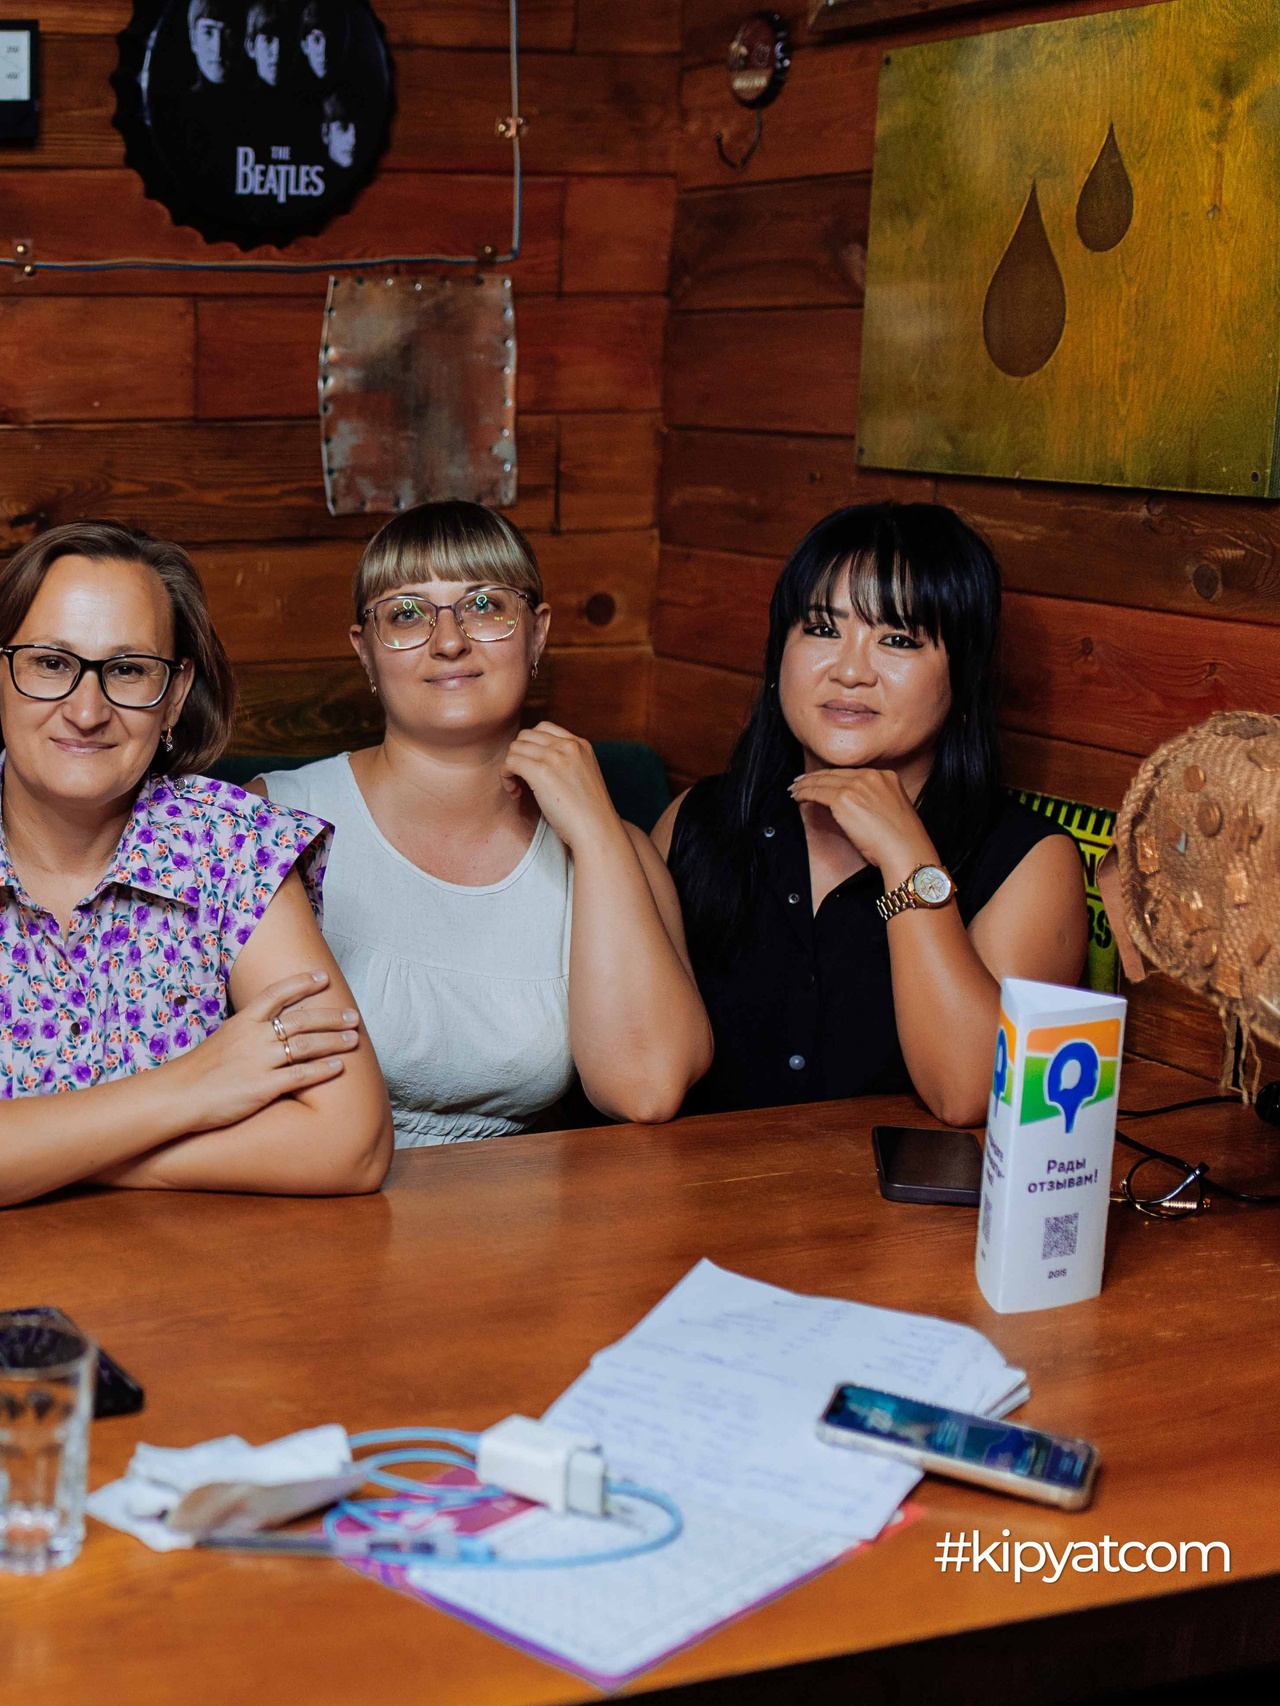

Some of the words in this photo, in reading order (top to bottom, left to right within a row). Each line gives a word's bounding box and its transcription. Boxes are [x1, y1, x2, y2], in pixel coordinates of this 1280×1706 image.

[270, 145, 291, 160] THE
[235, 145, 325, 203] BEATLES
[1046, 1158, 1086, 1175] Рады
[1027, 1168, 1098, 1194] отзывам!
[1047, 1268, 1068, 1280] 2GIS
